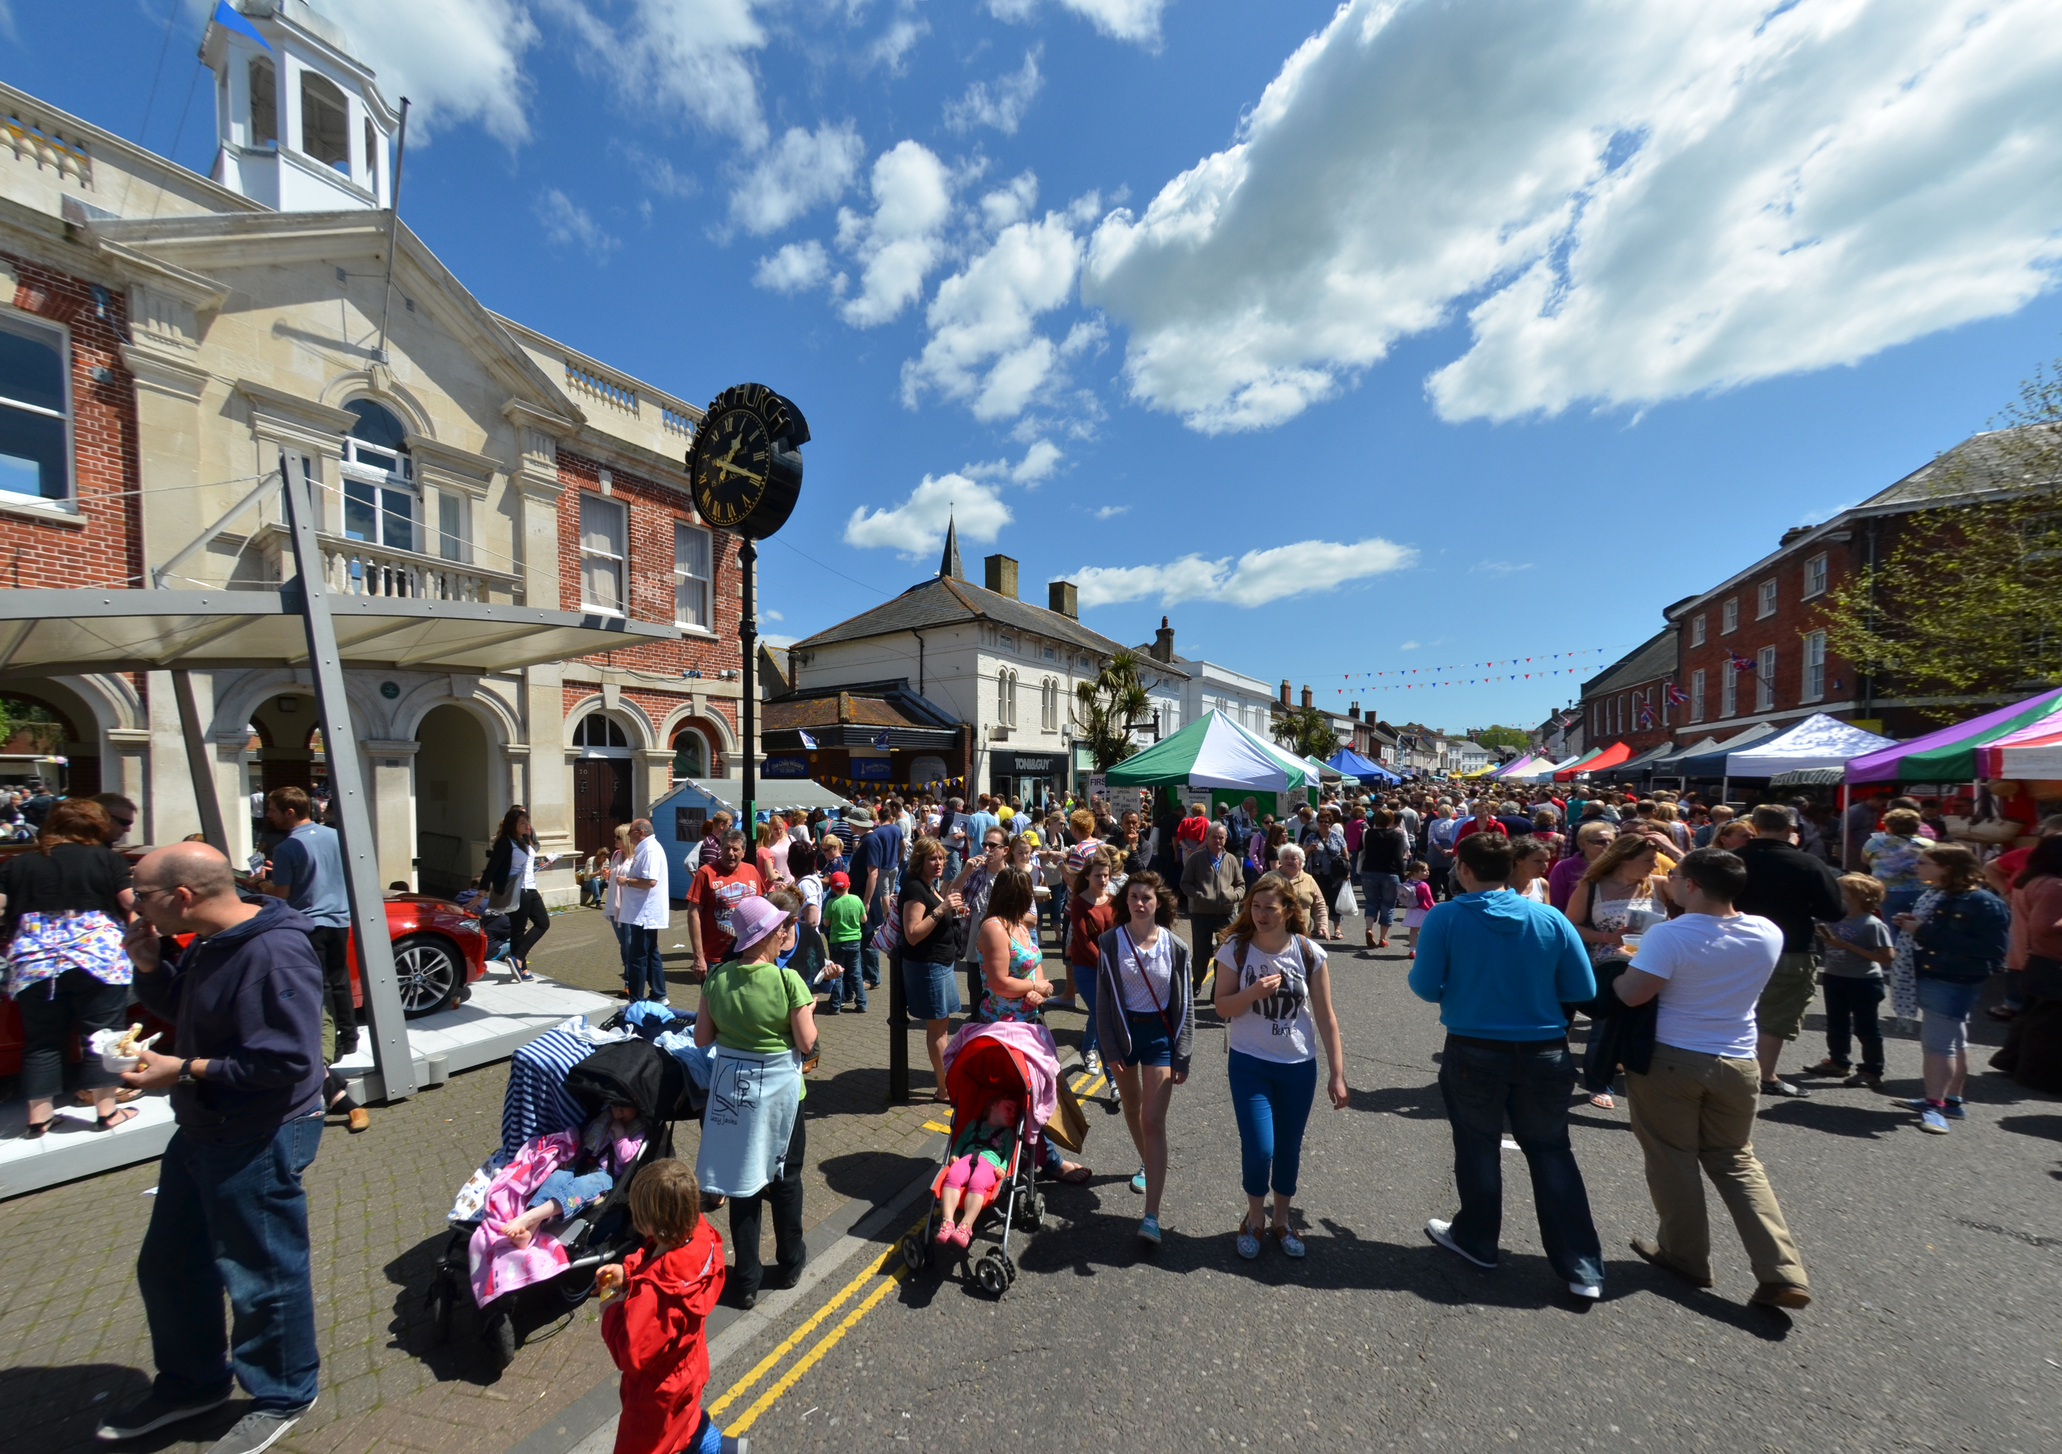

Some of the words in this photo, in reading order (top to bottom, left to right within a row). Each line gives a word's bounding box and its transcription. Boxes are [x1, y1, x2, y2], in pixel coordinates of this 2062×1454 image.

[685, 382, 790, 467] CHRISTCHURCH
[1014, 757, 1050, 770] TONI&GUY
[1090, 778, 1105, 786] FIRS
